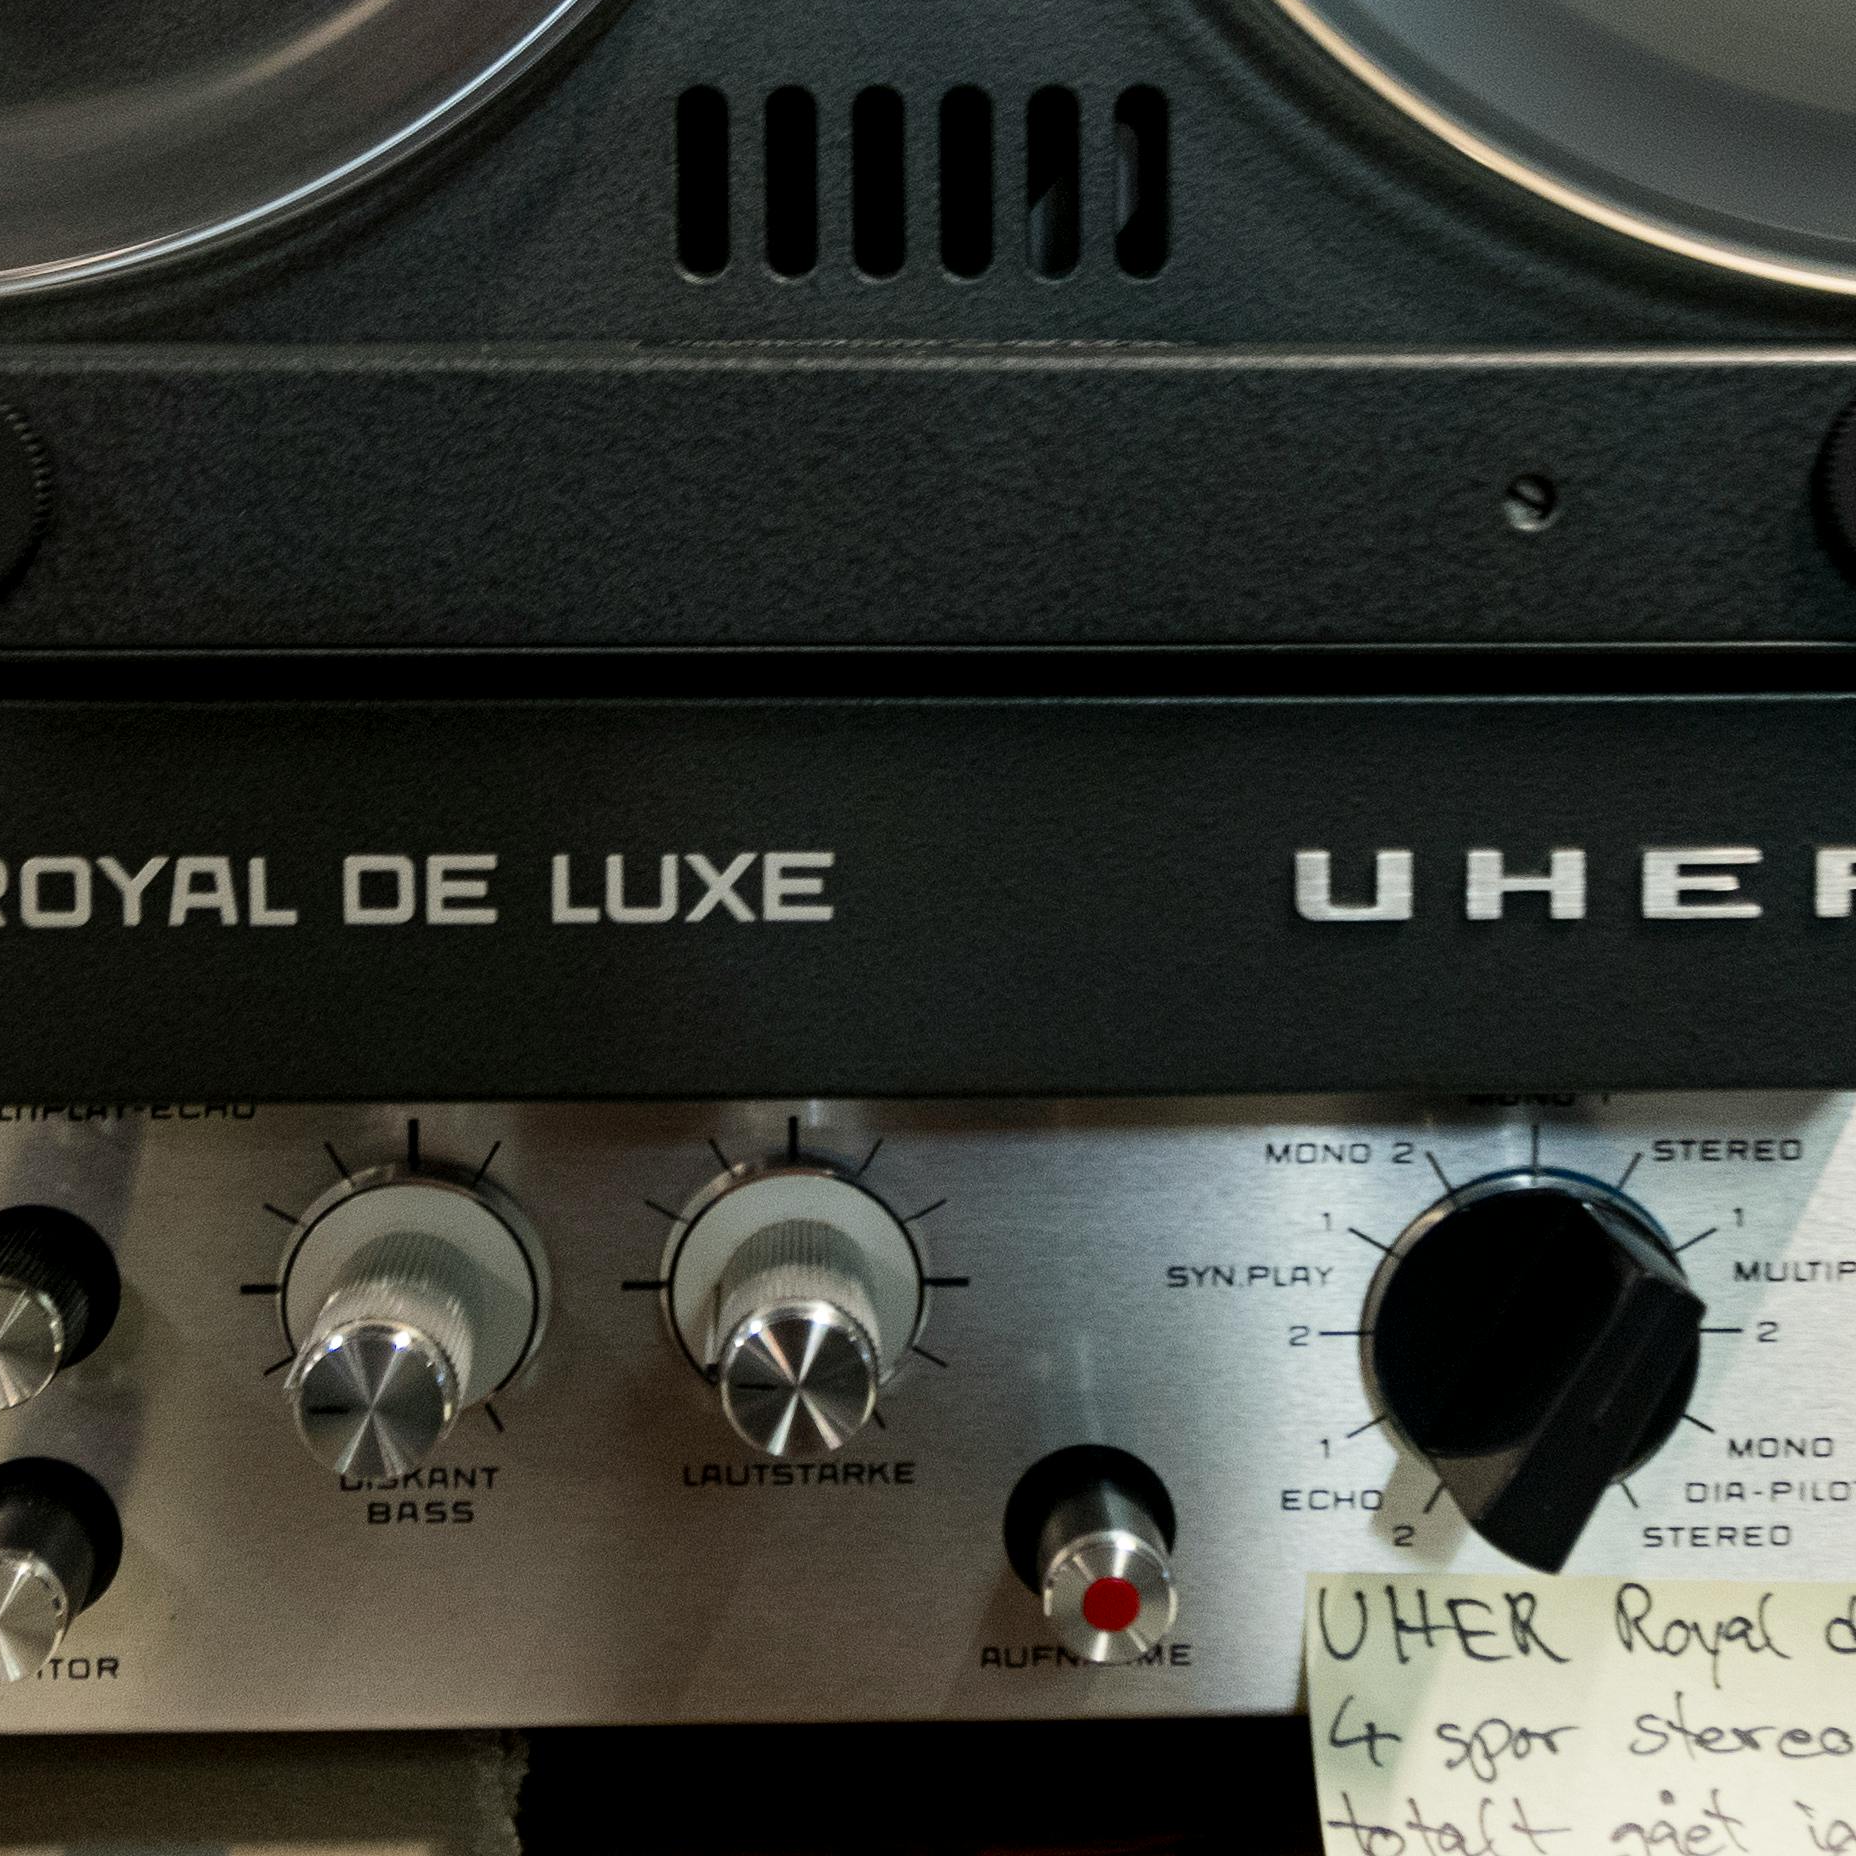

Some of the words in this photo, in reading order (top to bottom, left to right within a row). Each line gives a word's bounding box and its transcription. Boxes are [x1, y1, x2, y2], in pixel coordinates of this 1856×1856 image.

[342, 854, 498, 925] DE
[550, 852, 835, 923] LUXE
[1266, 1143, 1371, 1164] MONO
[1392, 1142, 1414, 1164] 2
[1652, 1138, 1802, 1162] STEREO
[1321, 1211, 1332, 1232] 1
[1733, 1206, 1744, 1227] 1
[1289, 1325, 1310, 1347] 2
[1758, 1321, 1779, 1343] 2
[1319, 1437, 1330, 1459] 1
[1728, 1436, 1833, 1459] MONO
[1281, 1489, 1383, 1511] ECHO
[367, 1500, 475, 1525] BASS
[1393, 1524, 1416, 1548] 2
[1642, 1524, 1792, 1548] STEREO
[1318, 1585, 1571, 1664] UHER
[1616, 1582, 1792, 1690] Royal
[980, 1644, 1192, 1669] AUFNME
[1329, 1695, 1402, 1768] 4
[1435, 1718, 1580, 1784] spor
[1630, 1690, 1855, 1762] stereo
